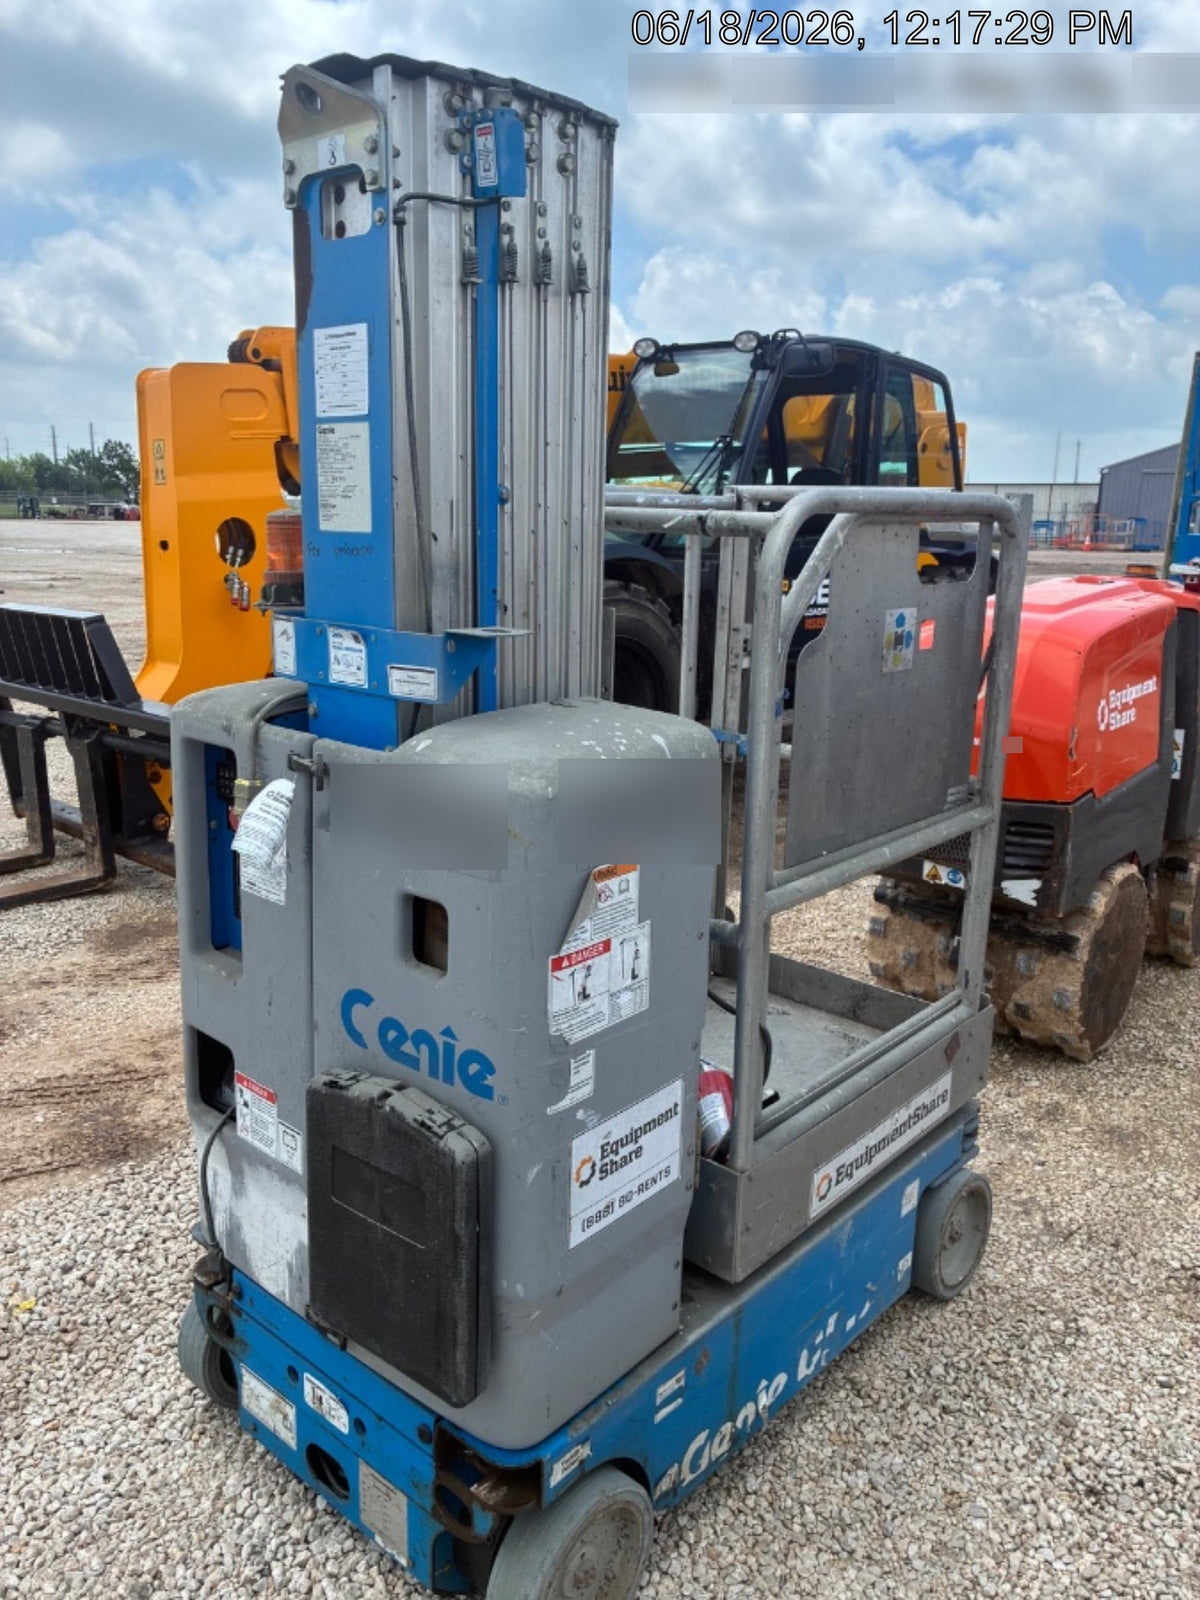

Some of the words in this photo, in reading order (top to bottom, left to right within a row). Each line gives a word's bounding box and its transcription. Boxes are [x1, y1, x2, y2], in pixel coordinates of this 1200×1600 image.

[1109, 676, 1157, 709] Equipment
[1109, 708, 1136, 731] Share
[599, 1102, 680, 1161] Equipment
[834, 1089, 949, 1187] EquipmentShare
[598, 1145, 643, 1181] Share
